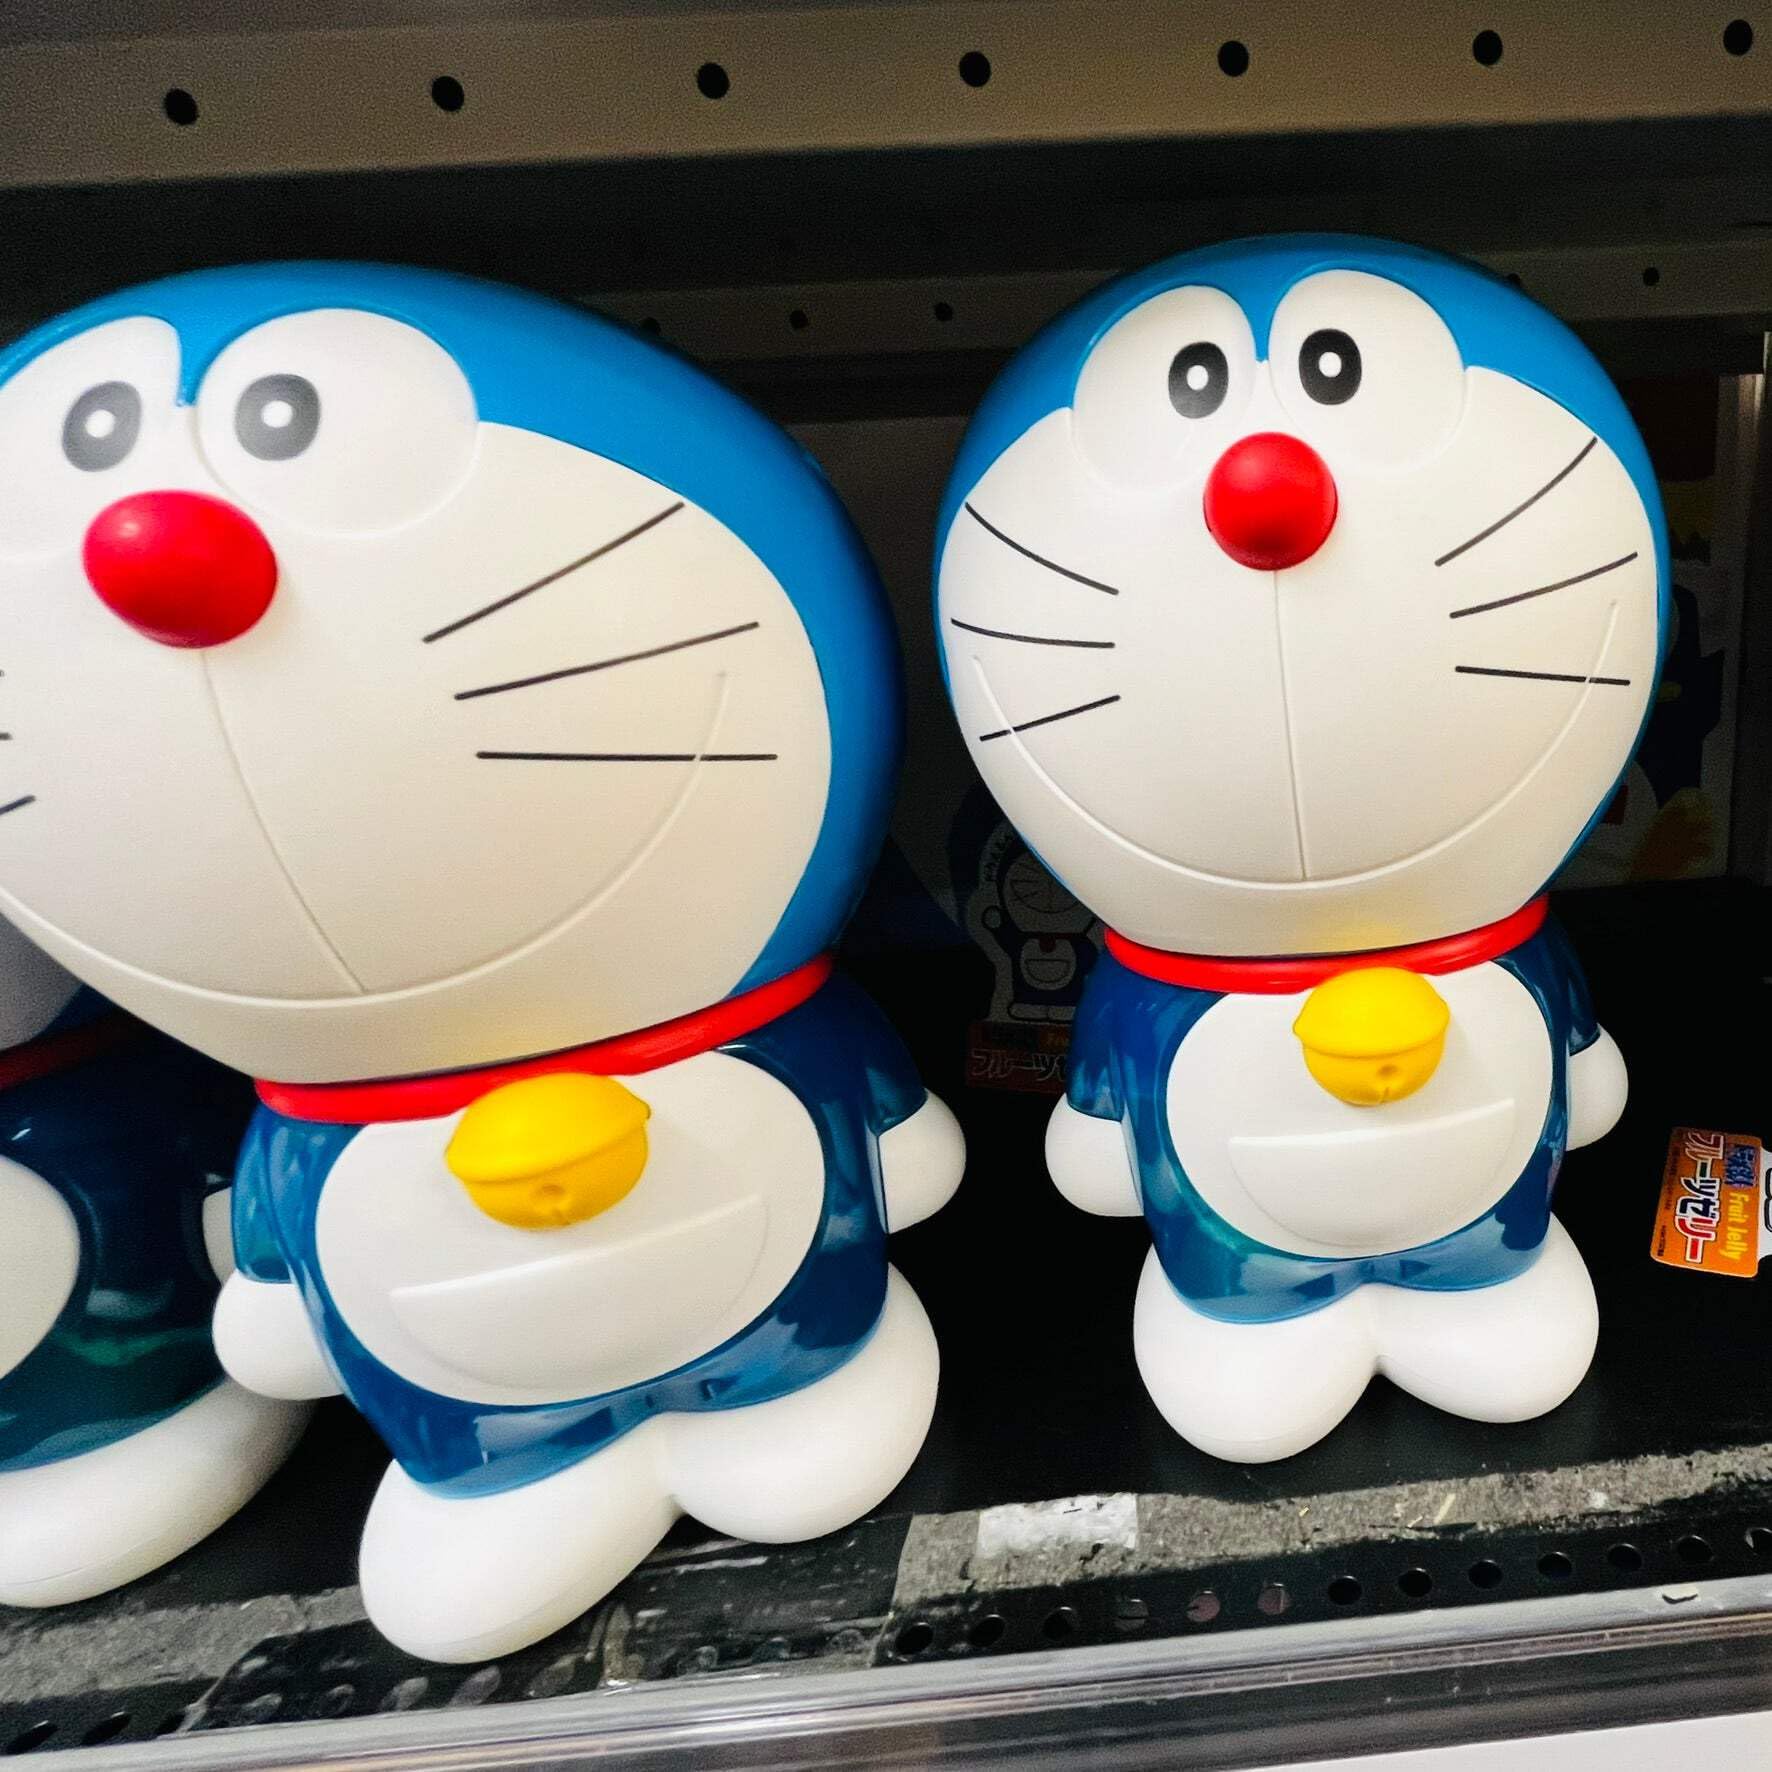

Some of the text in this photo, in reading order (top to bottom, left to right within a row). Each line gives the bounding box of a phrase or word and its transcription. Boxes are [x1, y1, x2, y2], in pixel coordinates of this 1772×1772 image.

[971, 1047, 1064, 1081] フルーツ
[1675, 1132, 1724, 1263] フルーツゼリー
[1729, 1191, 1749, 1222] Fruit
[1720, 1224, 1749, 1260] Jelly
